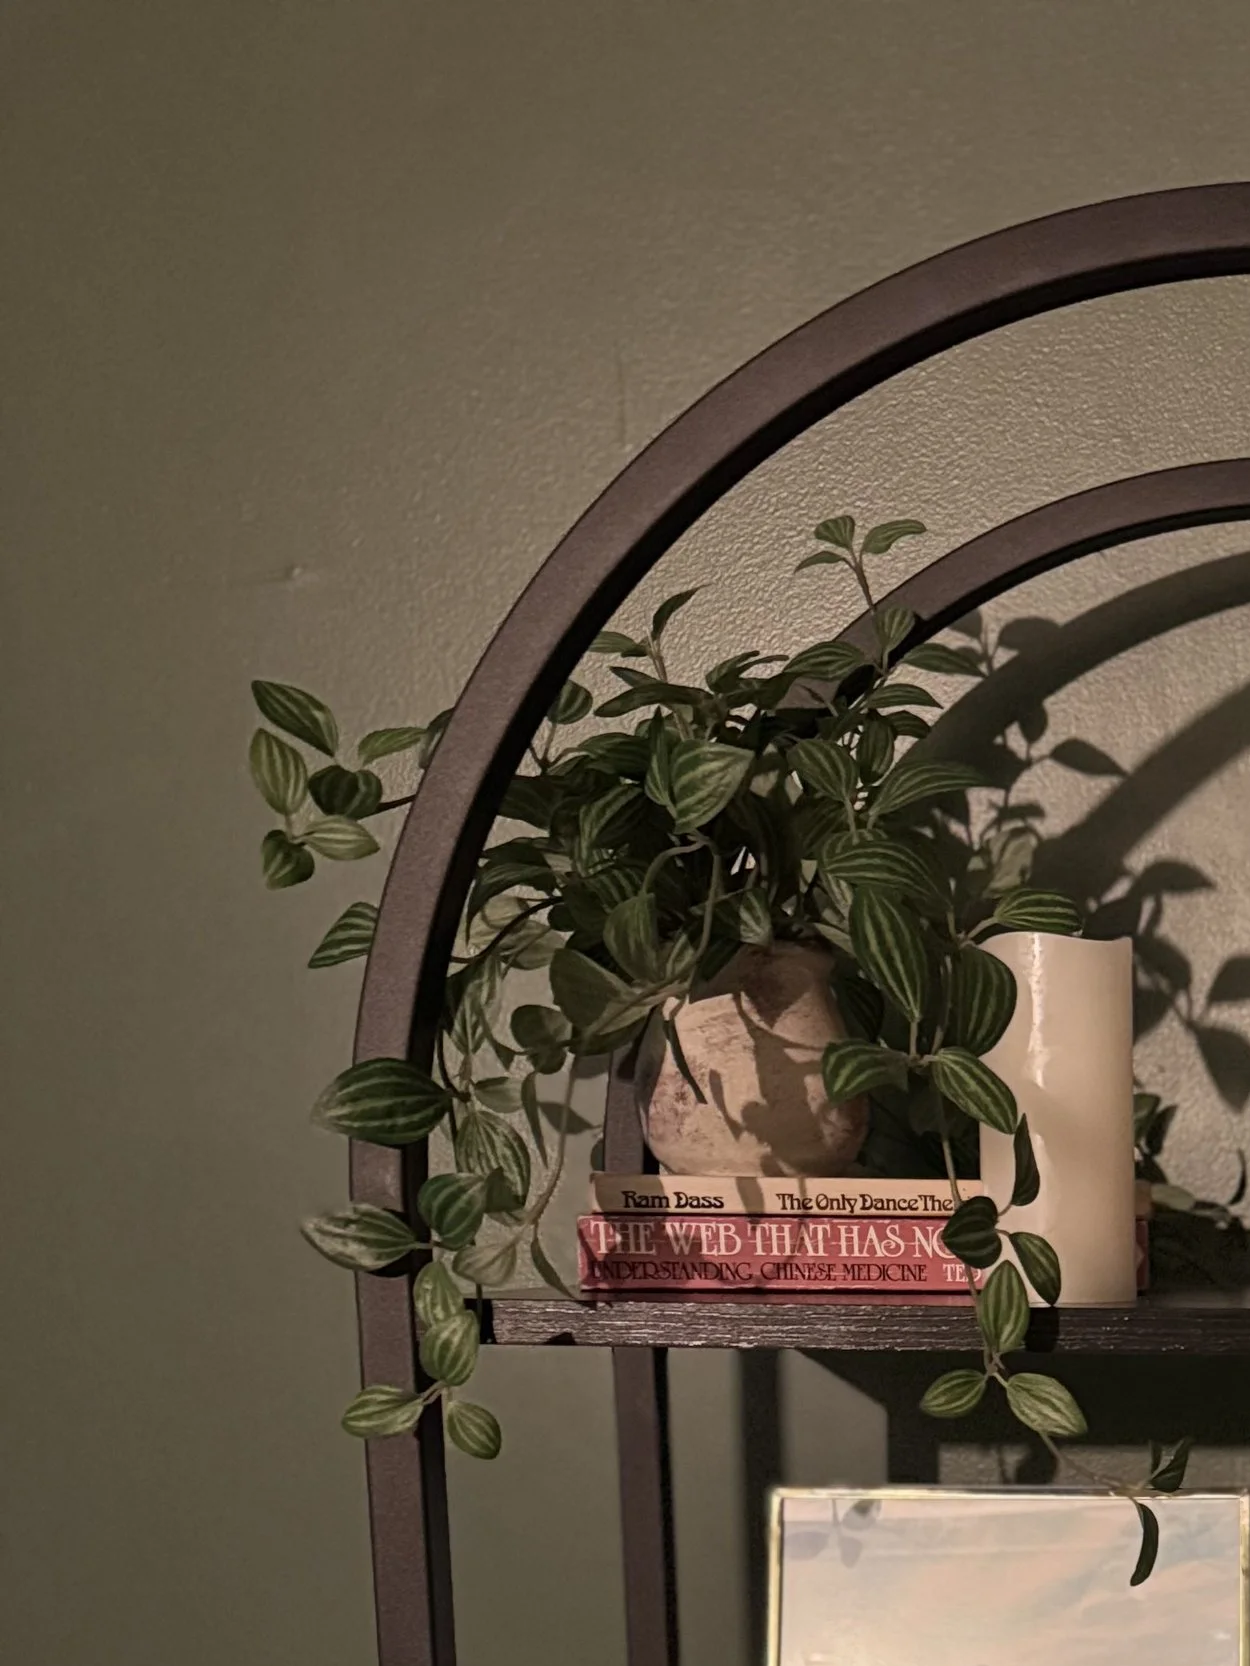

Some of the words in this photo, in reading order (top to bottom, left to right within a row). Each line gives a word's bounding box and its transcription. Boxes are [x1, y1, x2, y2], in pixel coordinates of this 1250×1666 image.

[621, 1191, 670, 1209] Ram
[673, 1191, 725, 1209] Dass
[776, 1193, 813, 1211] The
[815, 1193, 857, 1214] Only
[859, 1194, 919, 1212] Dance
[919, 1194, 954, 1212] The
[589, 1219, 656, 1255] THE
[664, 1221, 742, 1257] WEB
[747, 1222, 830, 1257] THAT
[837, 1223, 905, 1258] HAS
[589, 1260, 753, 1281] UNDERSTANDING
[760, 1262, 837, 1281] CHINESE
[842, 1263, 928, 1282] MEDICINE
